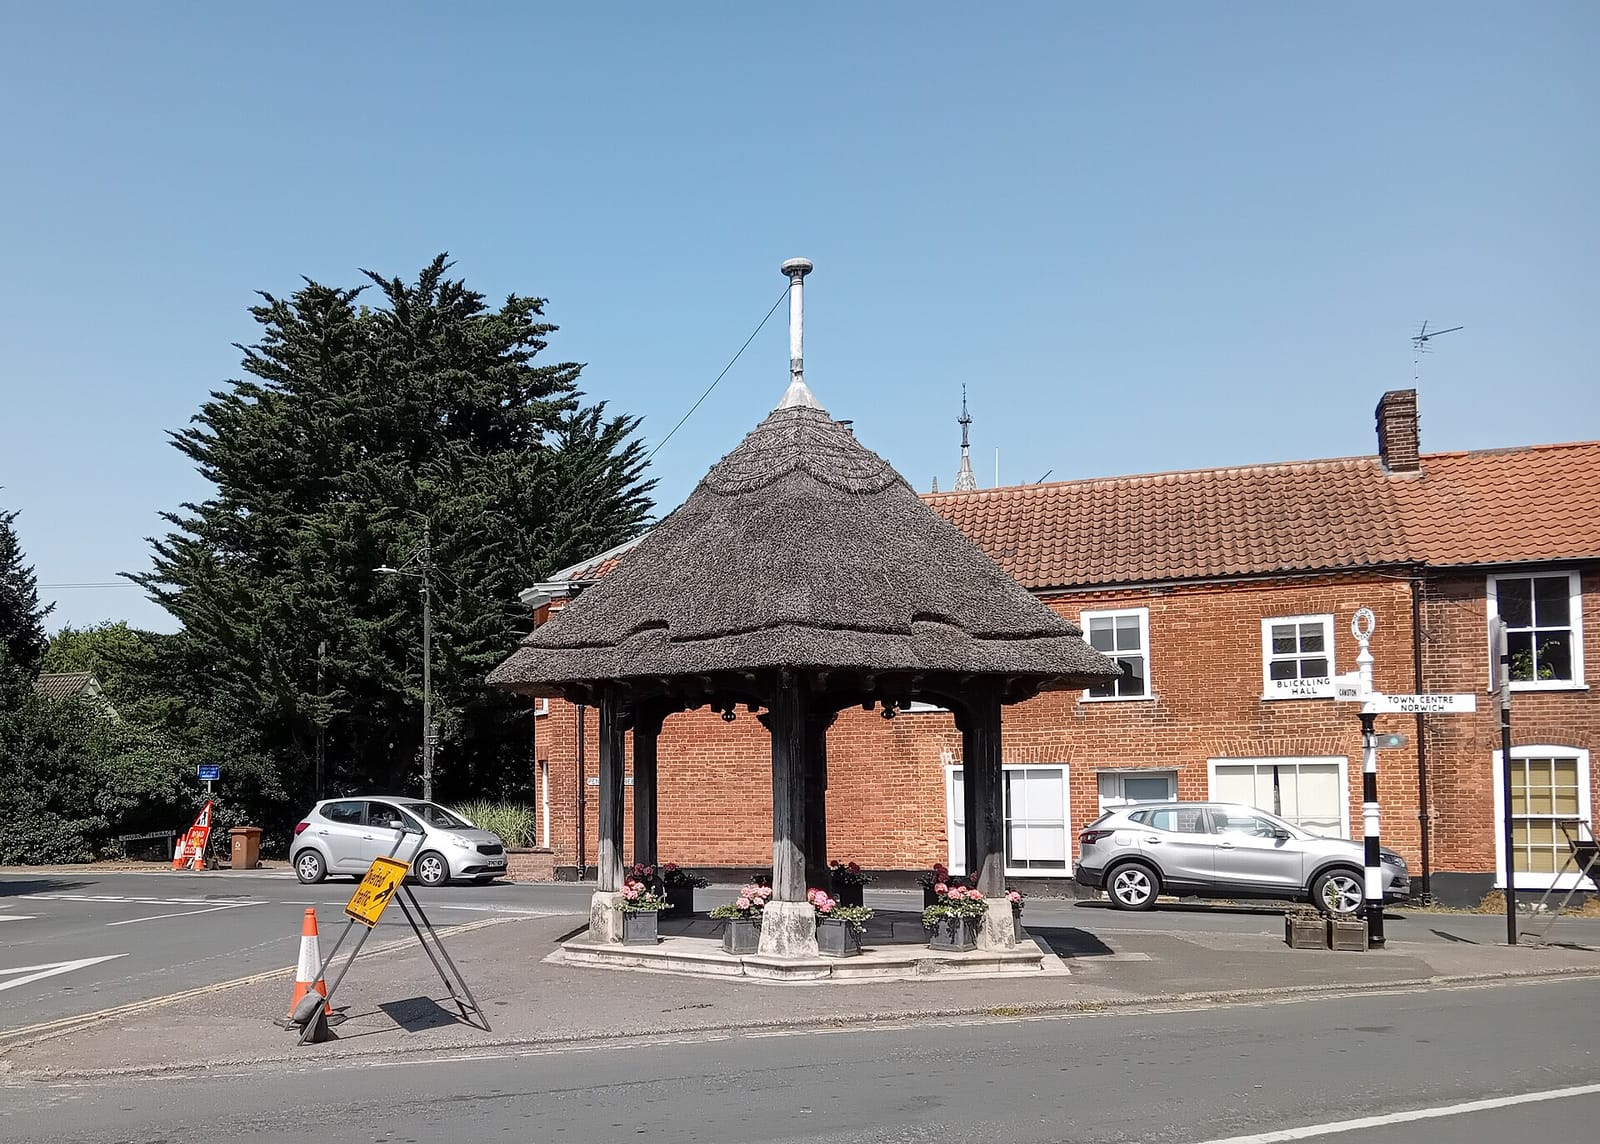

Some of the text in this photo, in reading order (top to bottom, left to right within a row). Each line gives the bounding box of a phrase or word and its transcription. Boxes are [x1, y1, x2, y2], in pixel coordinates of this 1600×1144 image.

[1277, 678, 1330, 688] BLICKLING
[1292, 687, 1317, 695] HALL
[1338, 688, 1357, 696] CAWSTON
[1387, 696, 1454, 704] TOWN CENTRE
[364, 868, 389, 888] Diverted
